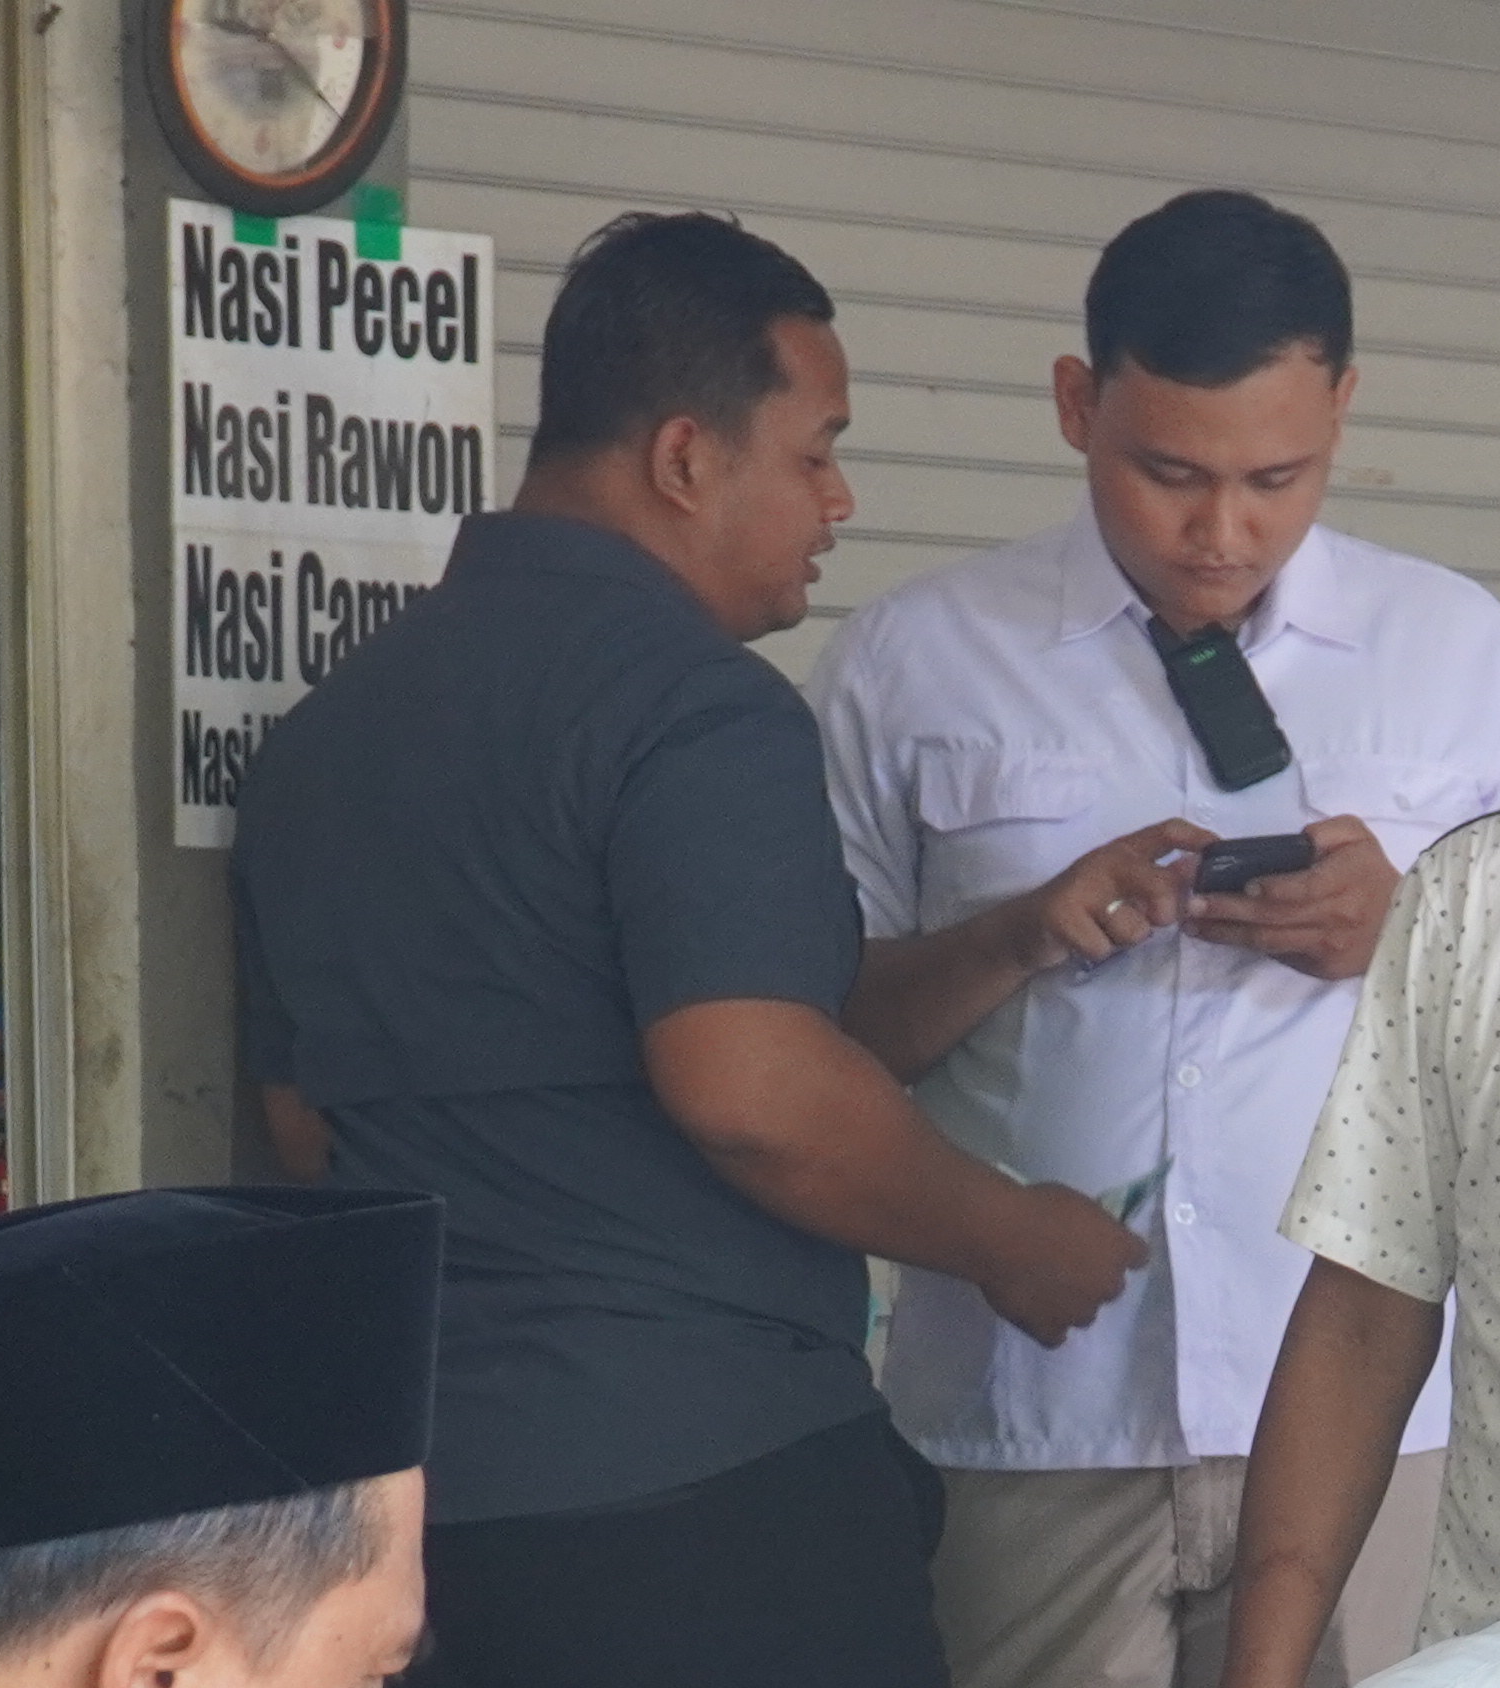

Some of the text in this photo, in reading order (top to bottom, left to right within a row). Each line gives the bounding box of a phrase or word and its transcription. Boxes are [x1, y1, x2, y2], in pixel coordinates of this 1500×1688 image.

[183, 222, 478, 364] Nasi Pecel
[183, 381, 484, 516] Nasi Rawon
[185, 543, 284, 684] Nasi
